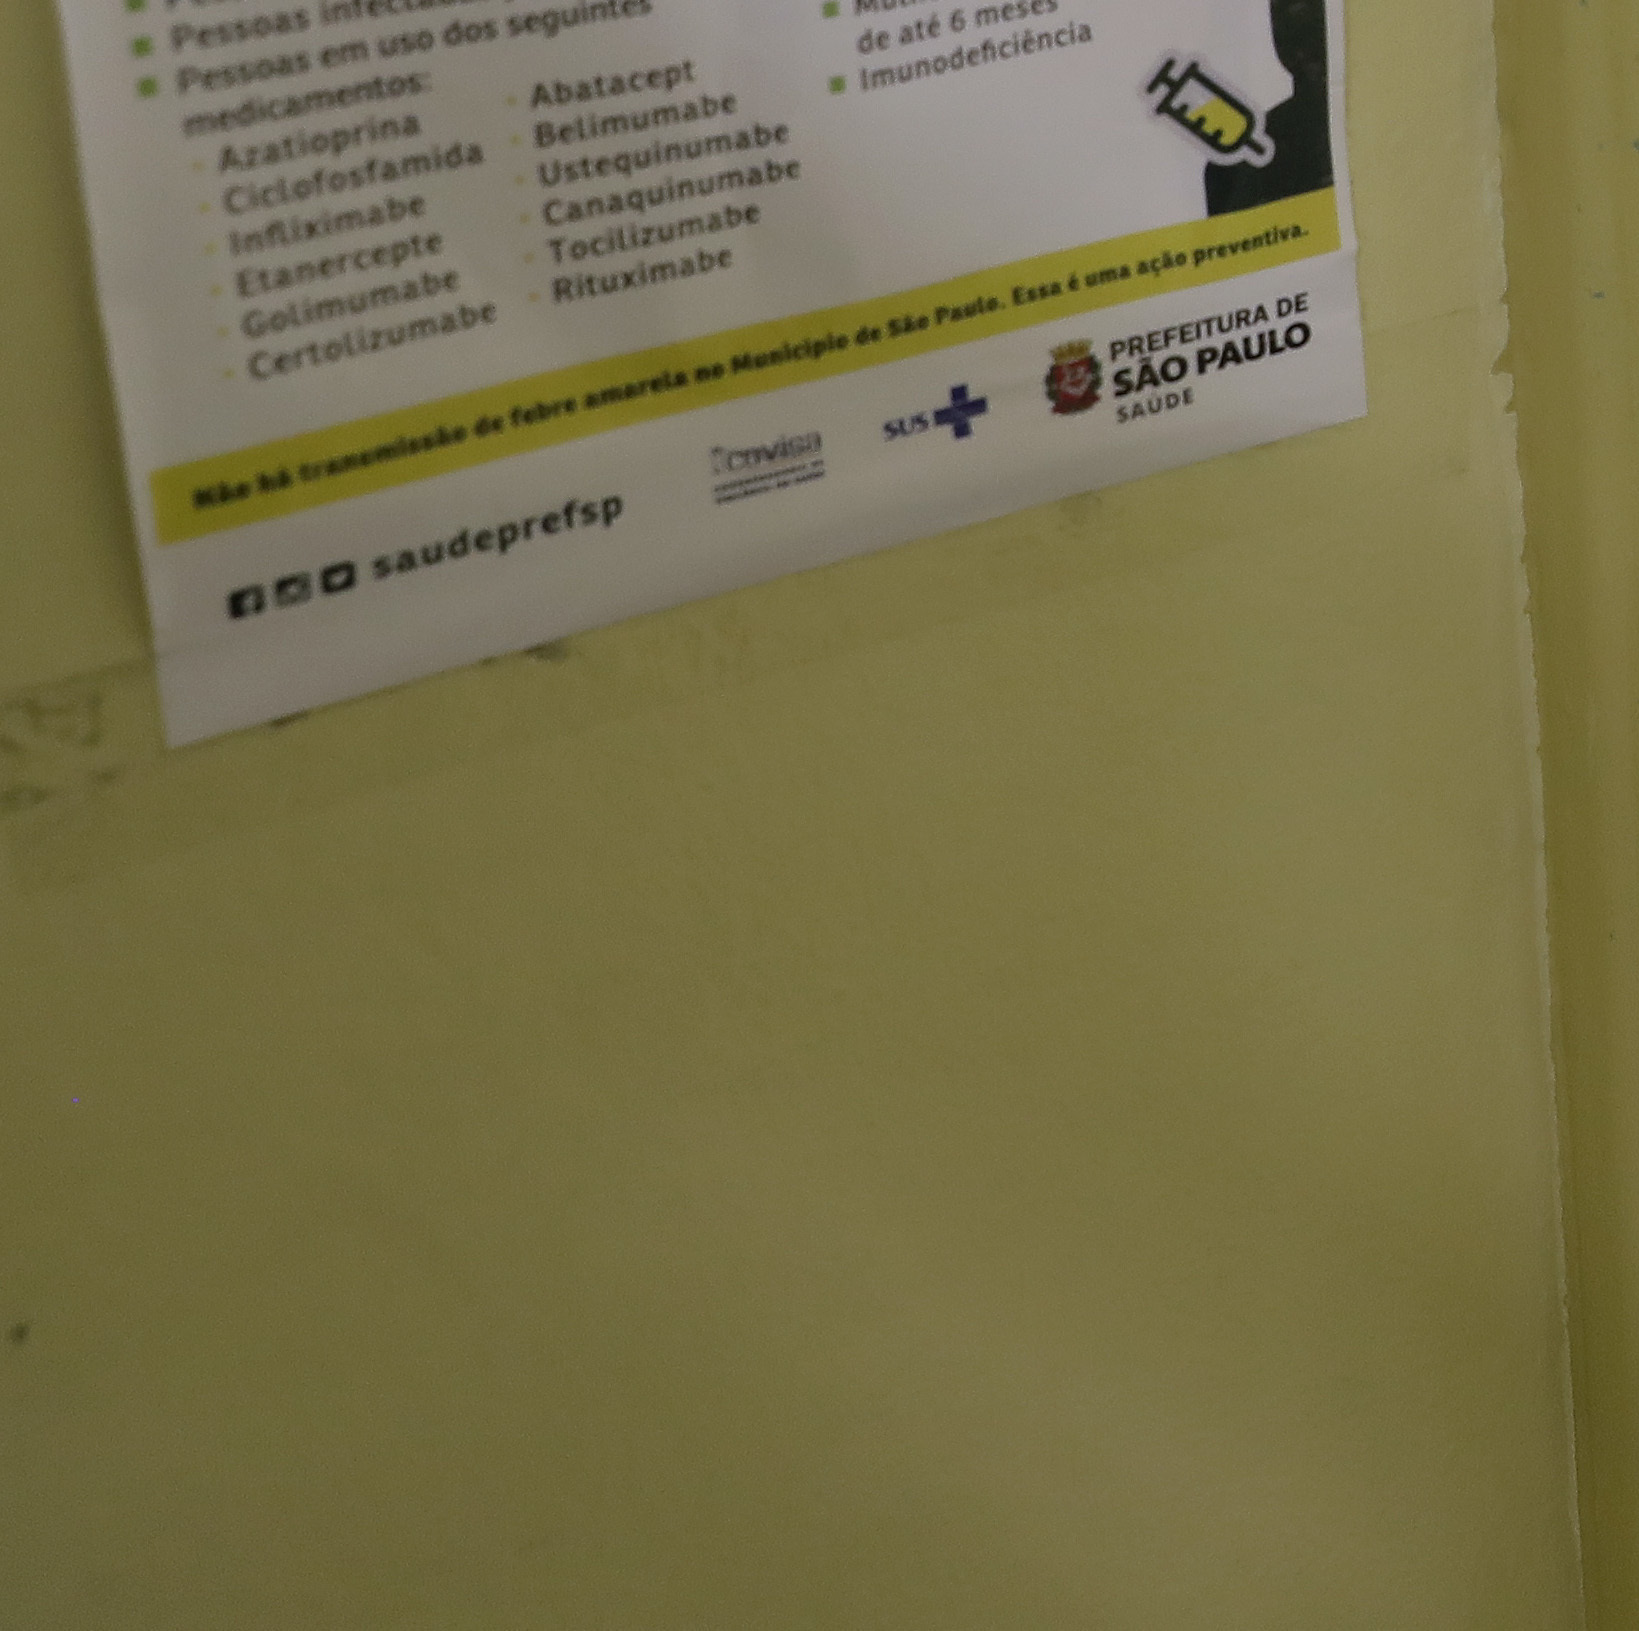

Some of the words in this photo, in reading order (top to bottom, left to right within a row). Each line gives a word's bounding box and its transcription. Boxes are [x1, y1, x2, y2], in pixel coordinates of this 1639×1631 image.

[170, 9, 310, 51] Pessoas
[175, 52, 311, 94] Pessoas
[318, 40, 369, 69] em
[377, 29, 435, 58] uso
[442, 19, 499, 47] dos
[857, 29, 890, 55] de
[899, 14, 940, 45] até
[949, 8, 966, 33] 6
[530, 60, 695, 109] Abatacept
[533, 94, 736, 149] Belimumabe
[537, 123, 789, 187] Ustequinumabe
[547, 204, 760, 264] Tocilizumabe
[551, 248, 731, 303] Rituximabe
[473, 416, 504, 437] de
[509, 398, 577, 427] febre
[584, 371, 689, 410] amarela
[854, 326, 882, 346] de
[886, 315, 929, 339] São
[1012, 281, 1063, 306] Essa
[1085, 264, 1131, 288] uma
[1110, 304, 1269, 362] PREFEITURA
[1276, 292, 1308, 319] DE
[1113, 355, 1188, 398] SÃO
[1197, 322, 1311, 375] PAULO
[883, 412, 929, 440] SUS
[1117, 387, 1193, 423] SAÚDE
[372, 495, 623, 580] saudeprefsp
